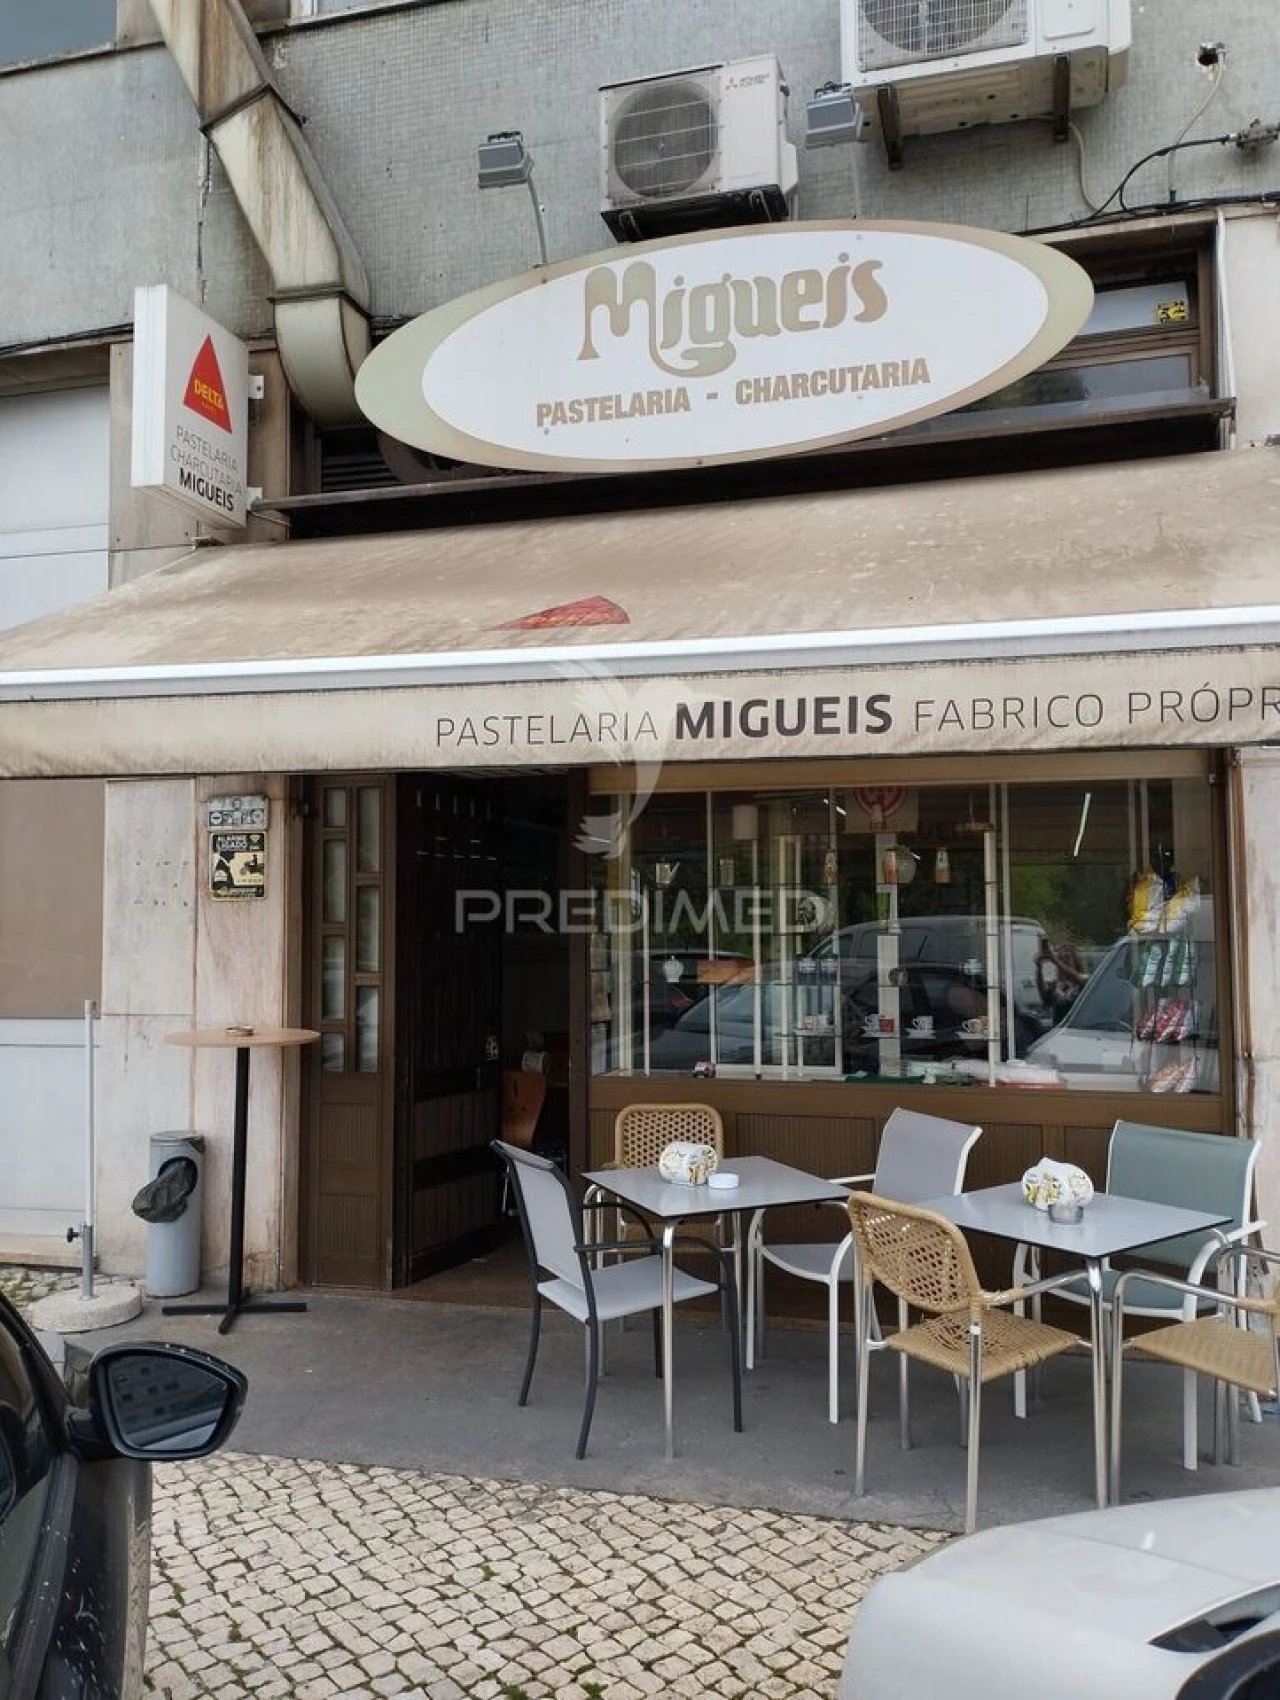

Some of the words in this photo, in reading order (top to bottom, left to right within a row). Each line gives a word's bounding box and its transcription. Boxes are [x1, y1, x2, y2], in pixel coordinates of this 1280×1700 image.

[577, 252, 888, 378] Migueis
[194, 379, 224, 411] DELTA
[536, 387, 692, 427] PASTELARIA
[735, 357, 931, 405] CHARCUTARIA
[169, 444, 242, 493] CHARCUTARIA
[176, 425, 238, 473] PASTELARIA
[179, 467, 235, 512] MIGUEIS
[436, 710, 659, 748] PASTELARIA
[675, 693, 893, 740] MIGUEIS
[914, 694, 1104, 732] FABRICO
[1128, 681, 1280, 724] PRÓPR
